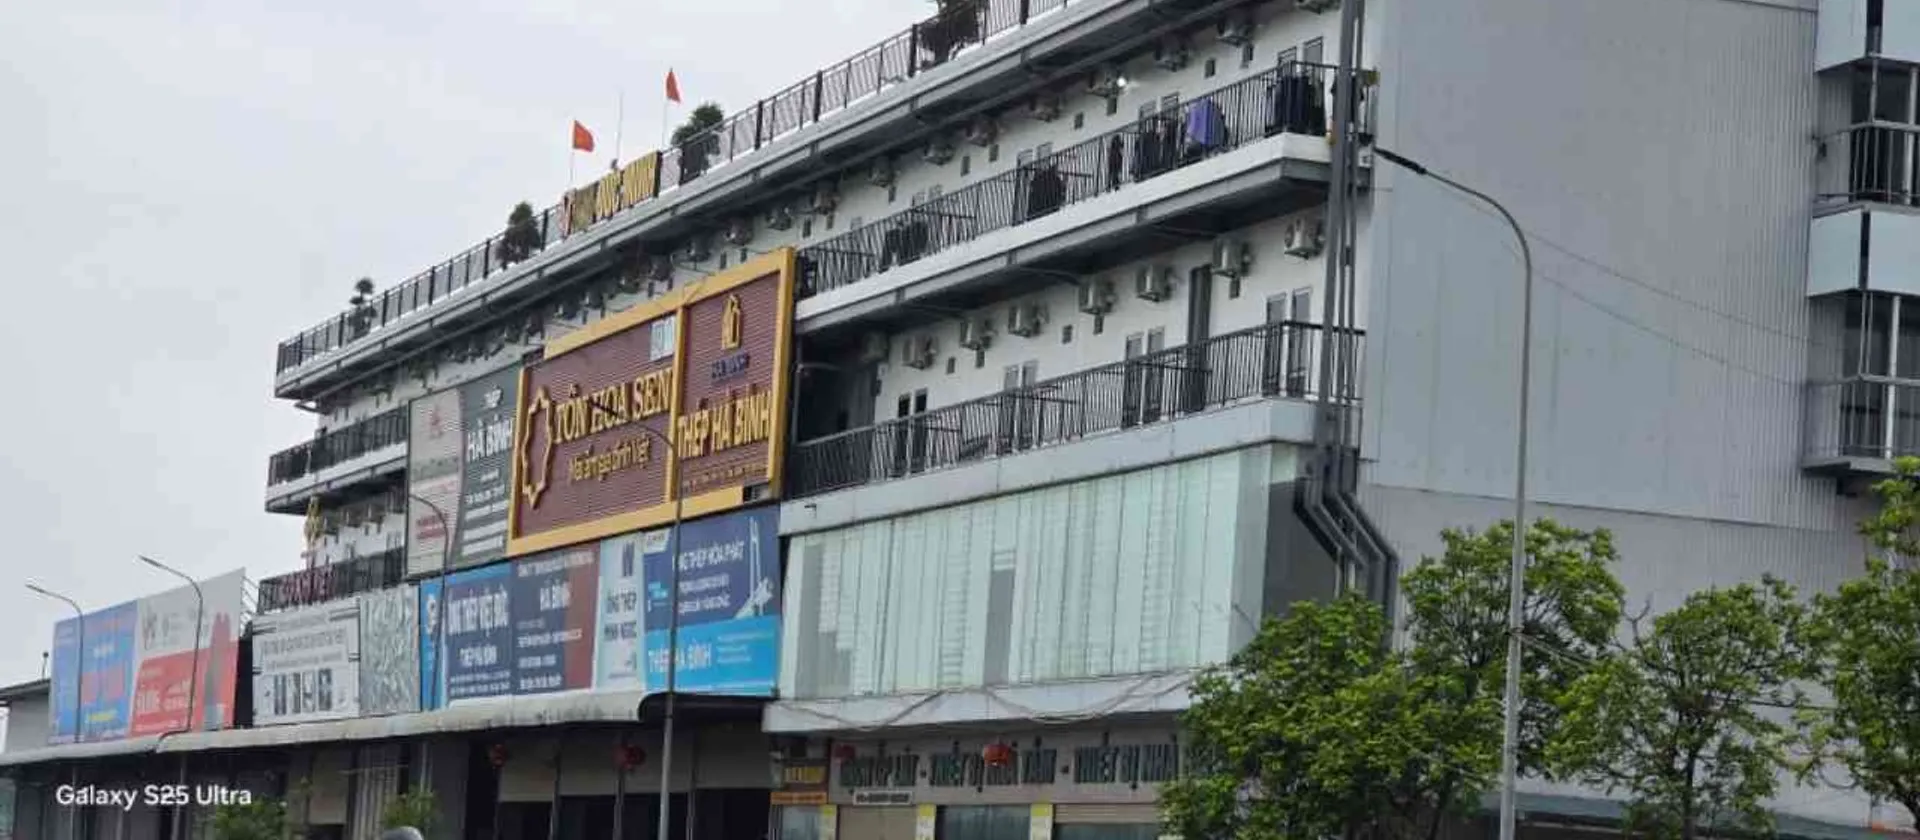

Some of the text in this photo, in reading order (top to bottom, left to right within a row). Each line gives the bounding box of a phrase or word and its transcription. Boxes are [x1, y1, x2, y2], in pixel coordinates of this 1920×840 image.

[555, 366, 673, 445] TÔN HOA SEN
[678, 383, 772, 459] THÉP HÀ BÌNH
[466, 412, 513, 463] HÀ BÌNH
[480, 587, 493, 637] VIỆT
